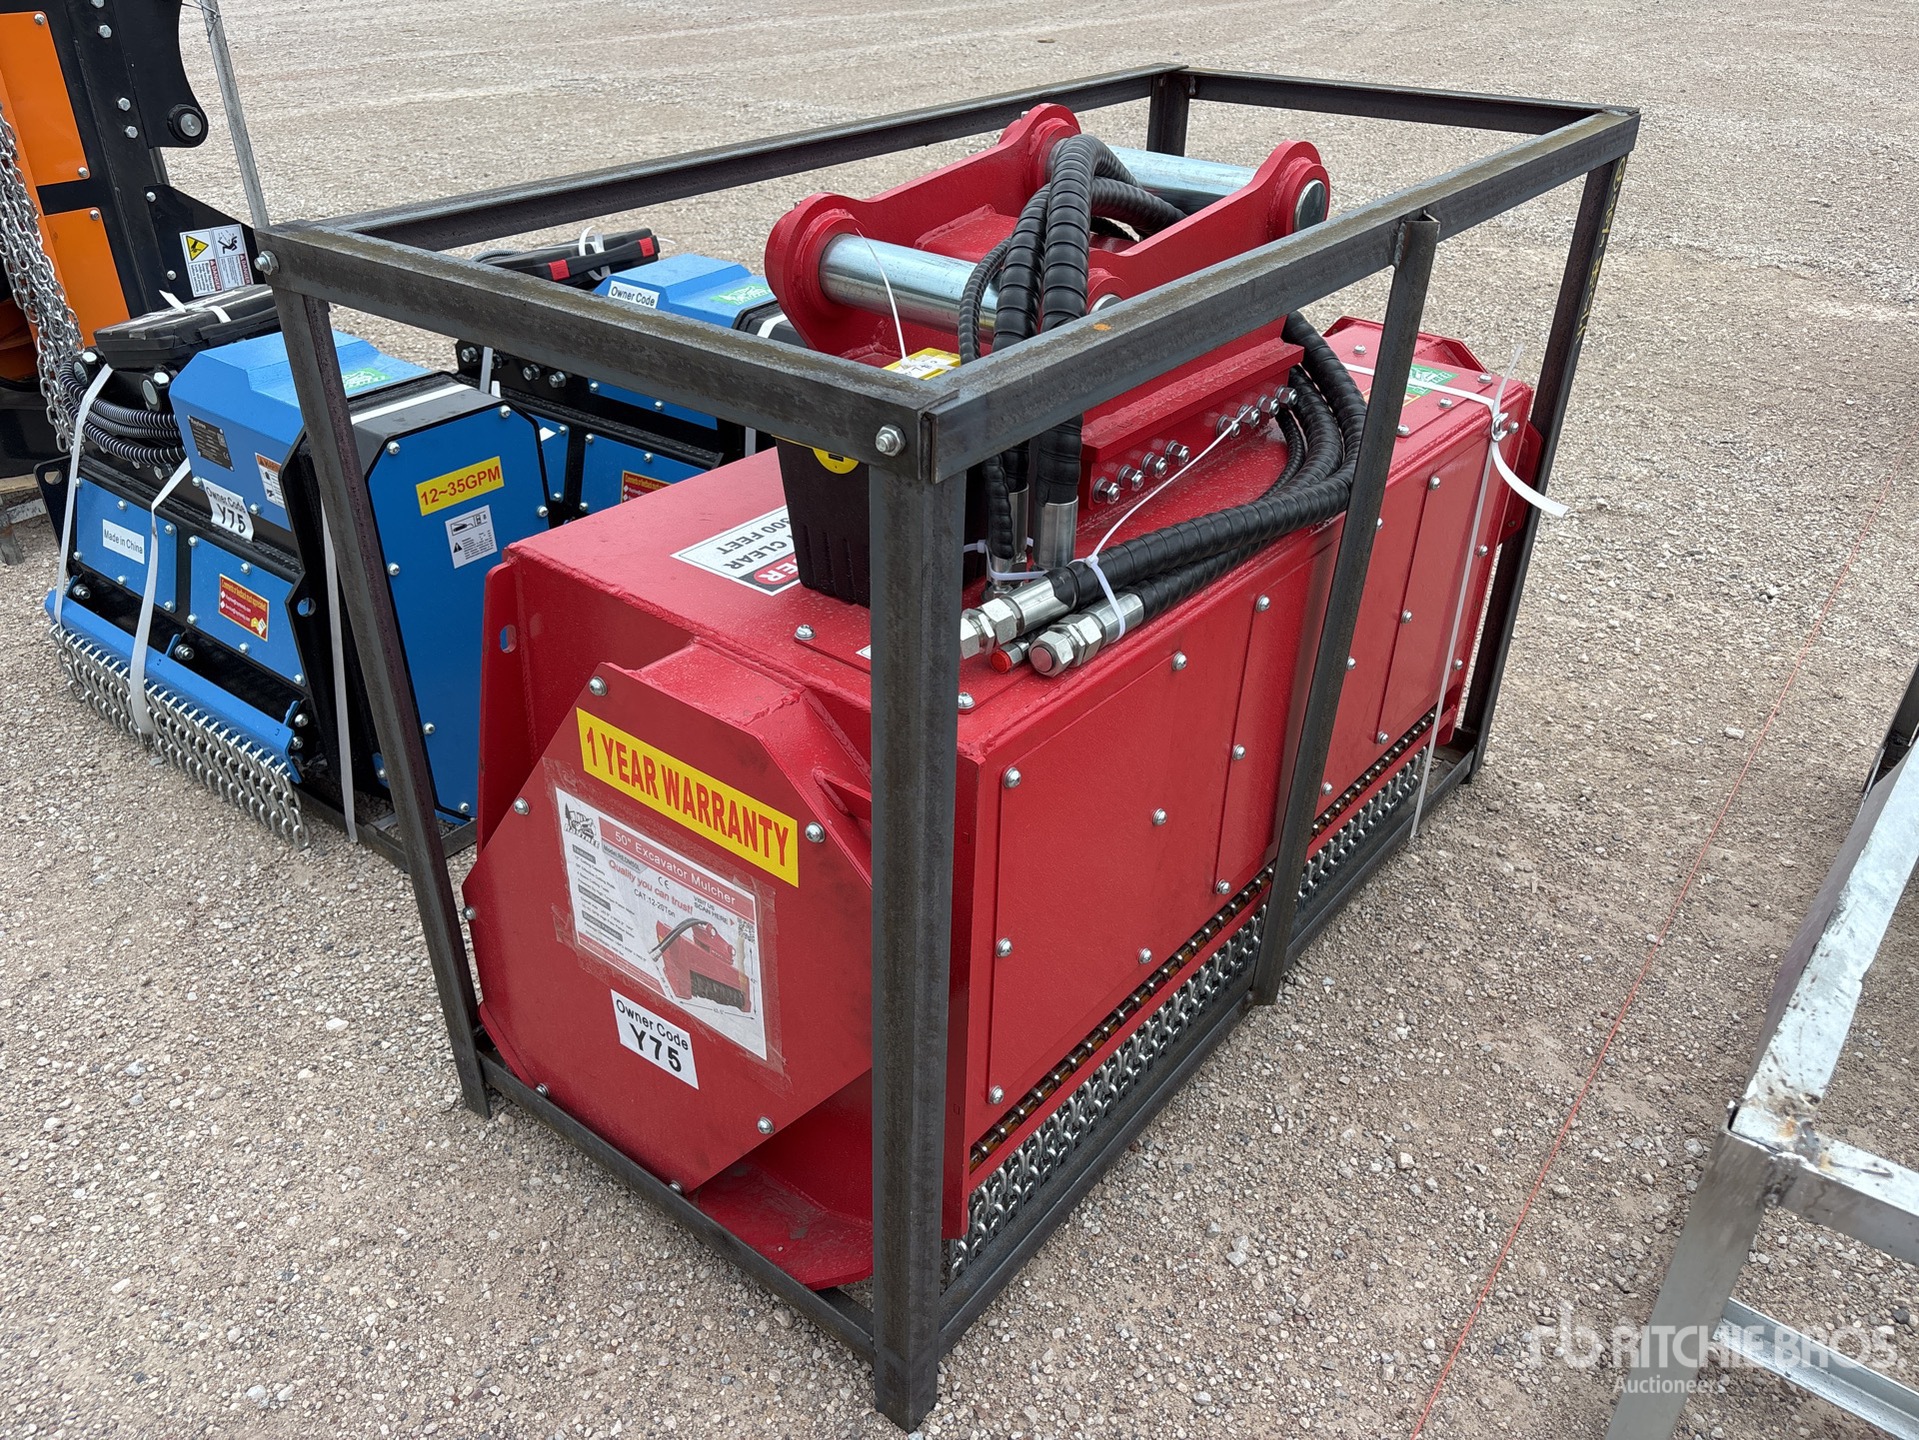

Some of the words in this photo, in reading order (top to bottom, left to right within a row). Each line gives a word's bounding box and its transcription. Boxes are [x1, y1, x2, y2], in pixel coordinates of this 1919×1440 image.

[610, 286, 635, 298] Owner
[635, 292, 655, 307] Code
[205, 486, 228, 506] Owner
[227, 496, 246, 514] Code
[420, 465, 501, 506] 12~35GPM
[216, 503, 247, 534] Y75
[103, 529, 120, 544] Made
[119, 537, 126, 547] in
[125, 538, 143, 555] China
[716, 531, 765, 555] FEET
[722, 540, 788, 570] CLEAR
[586, 726, 598, 768] 1
[600, 732, 659, 800] YEAR
[660, 764, 789, 868] WARRANTY
[608, 859, 637, 884] Quality
[637, 877, 653, 892] you
[654, 887, 670, 900] can
[671, 895, 693, 915] trust!
[635, 842, 688, 879] Excavator
[691, 872, 736, 905] Mulcher
[693, 902, 712, 916] SCAN
[711, 911, 729, 926] HERE
[616, 998, 654, 1031] Owner
[656, 1022, 689, 1051] Code
[628, 1022, 682, 1073] Y75
